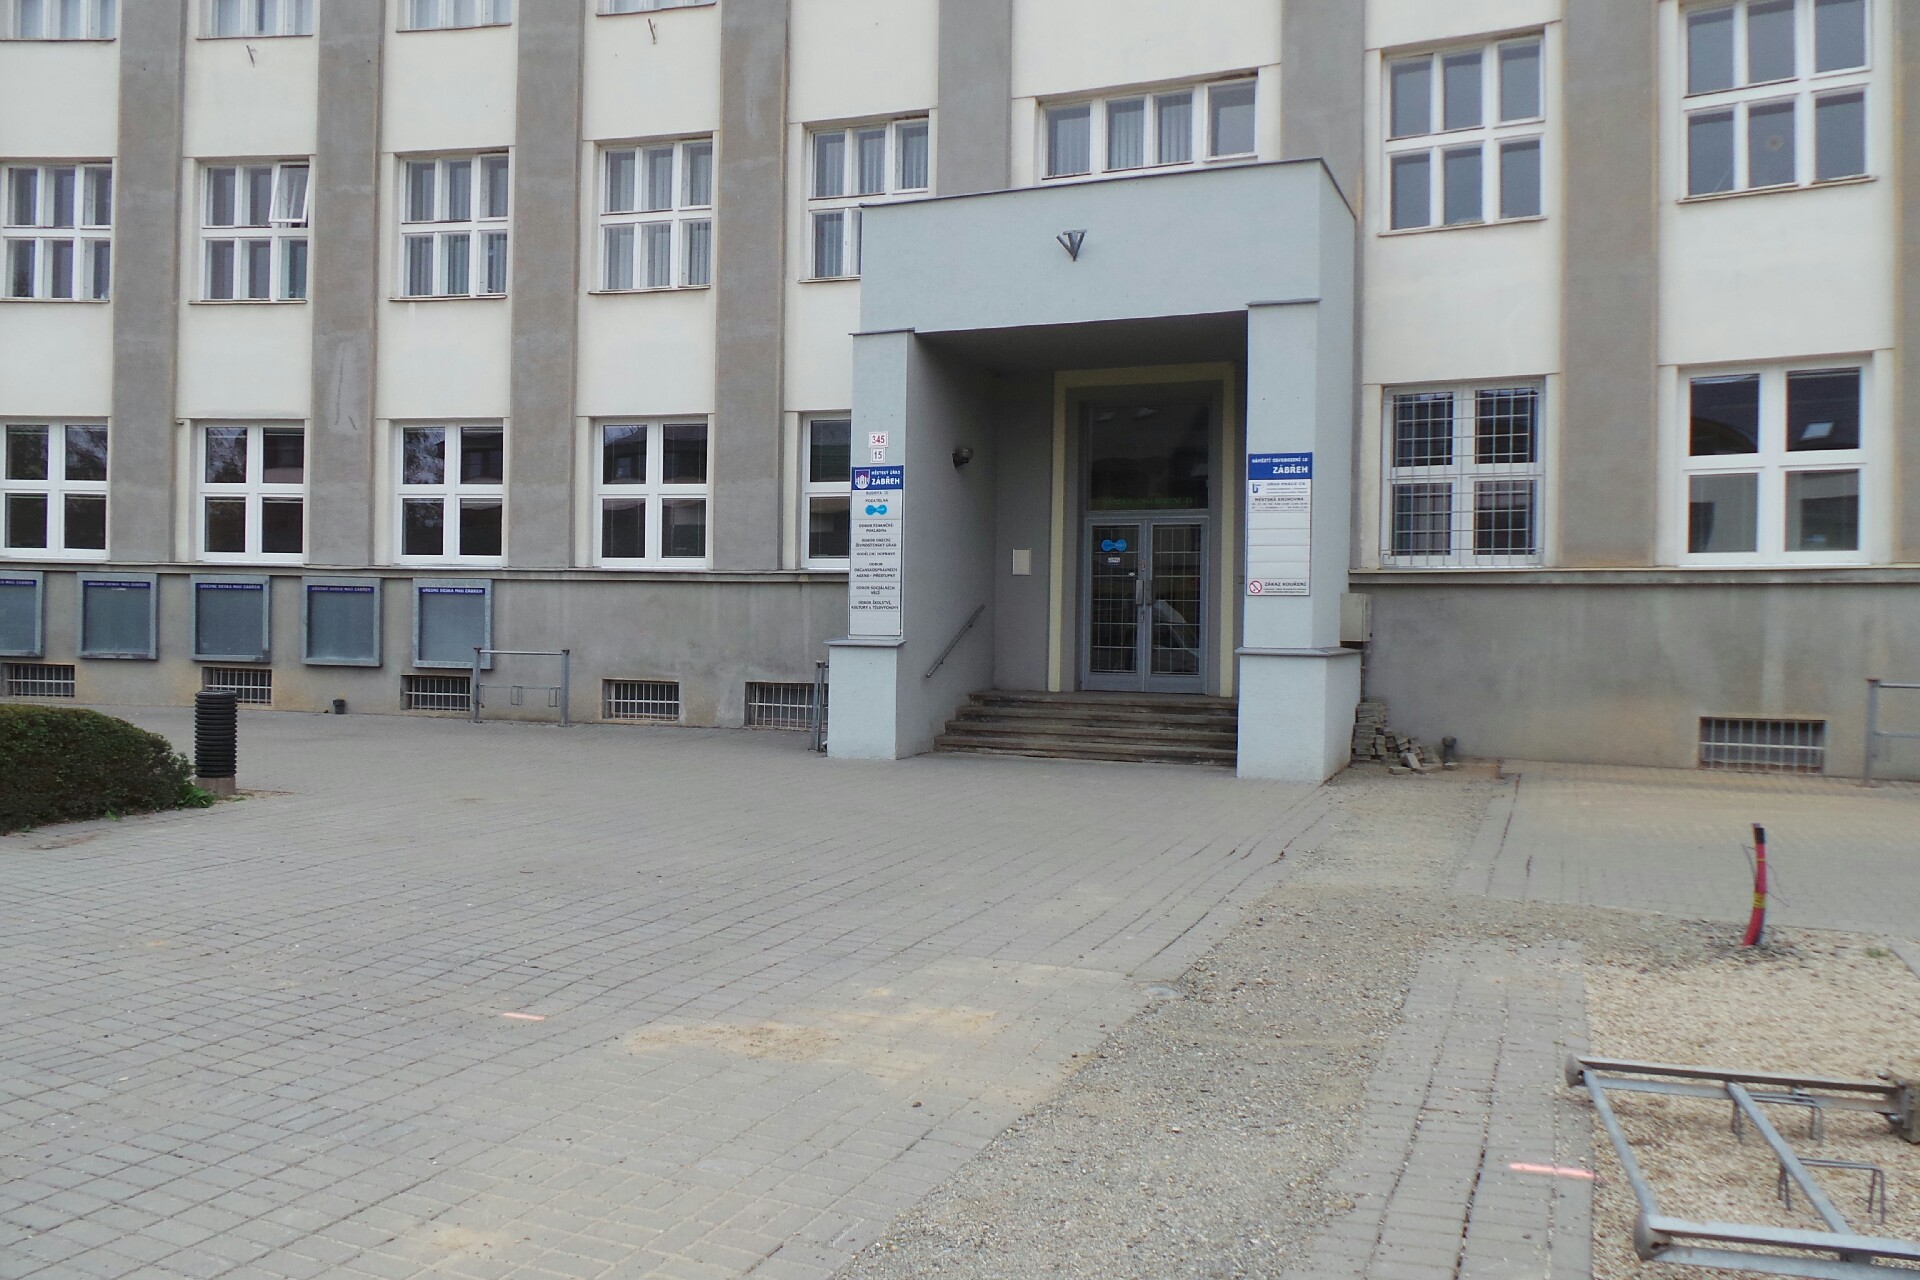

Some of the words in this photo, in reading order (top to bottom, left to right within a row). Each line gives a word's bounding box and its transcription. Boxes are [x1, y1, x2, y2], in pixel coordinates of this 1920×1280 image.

[872, 435, 885, 444] 345
[874, 451, 882, 459] 15
[1272, 464, 1308, 474] ZÁBŘEH
[871, 476, 900, 485] ZÁBŘEH
